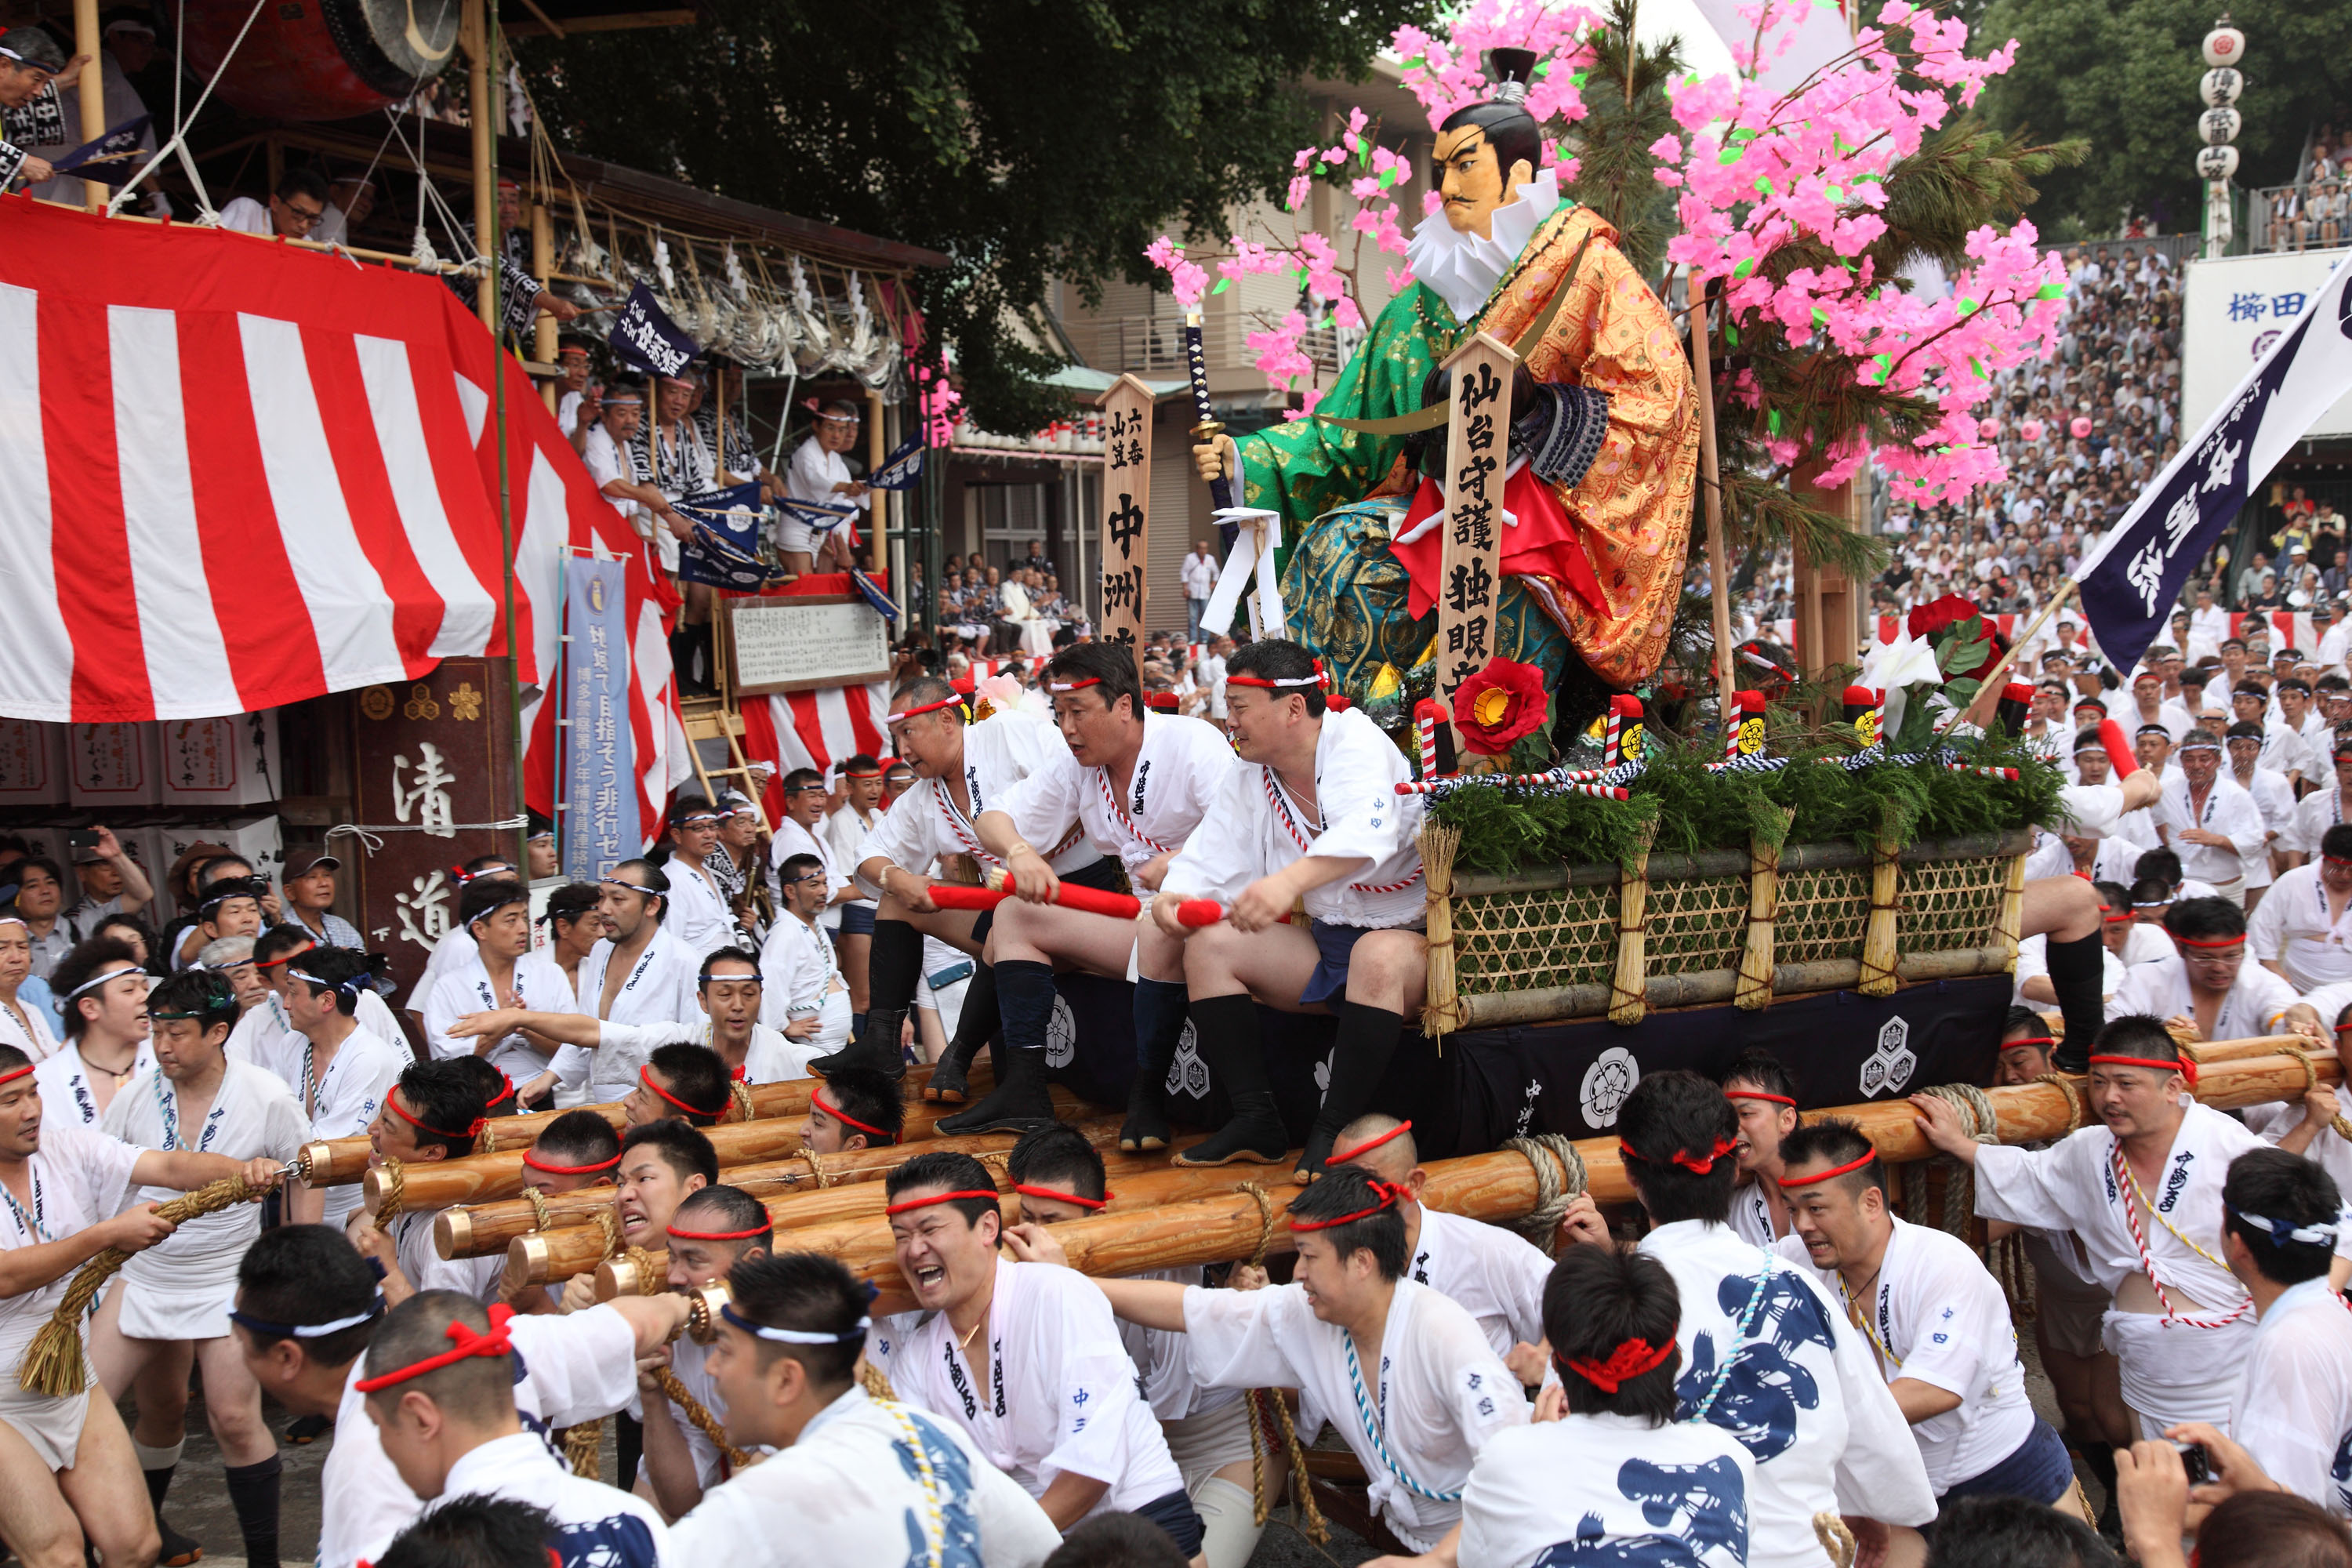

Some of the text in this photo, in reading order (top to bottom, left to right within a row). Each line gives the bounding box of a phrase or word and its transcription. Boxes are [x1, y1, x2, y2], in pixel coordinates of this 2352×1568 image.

[2227, 291, 2307, 322] 櫛田
[636, 321, 690, 377] 中洲流
[1110, 411, 1127, 470] 山笠
[1127, 408, 1144, 466] 六番
[2126, 437, 2243, 619] 中洲流
[393, 742, 456, 953] 清道
[1073, 1388, 1090, 1433] 中三
